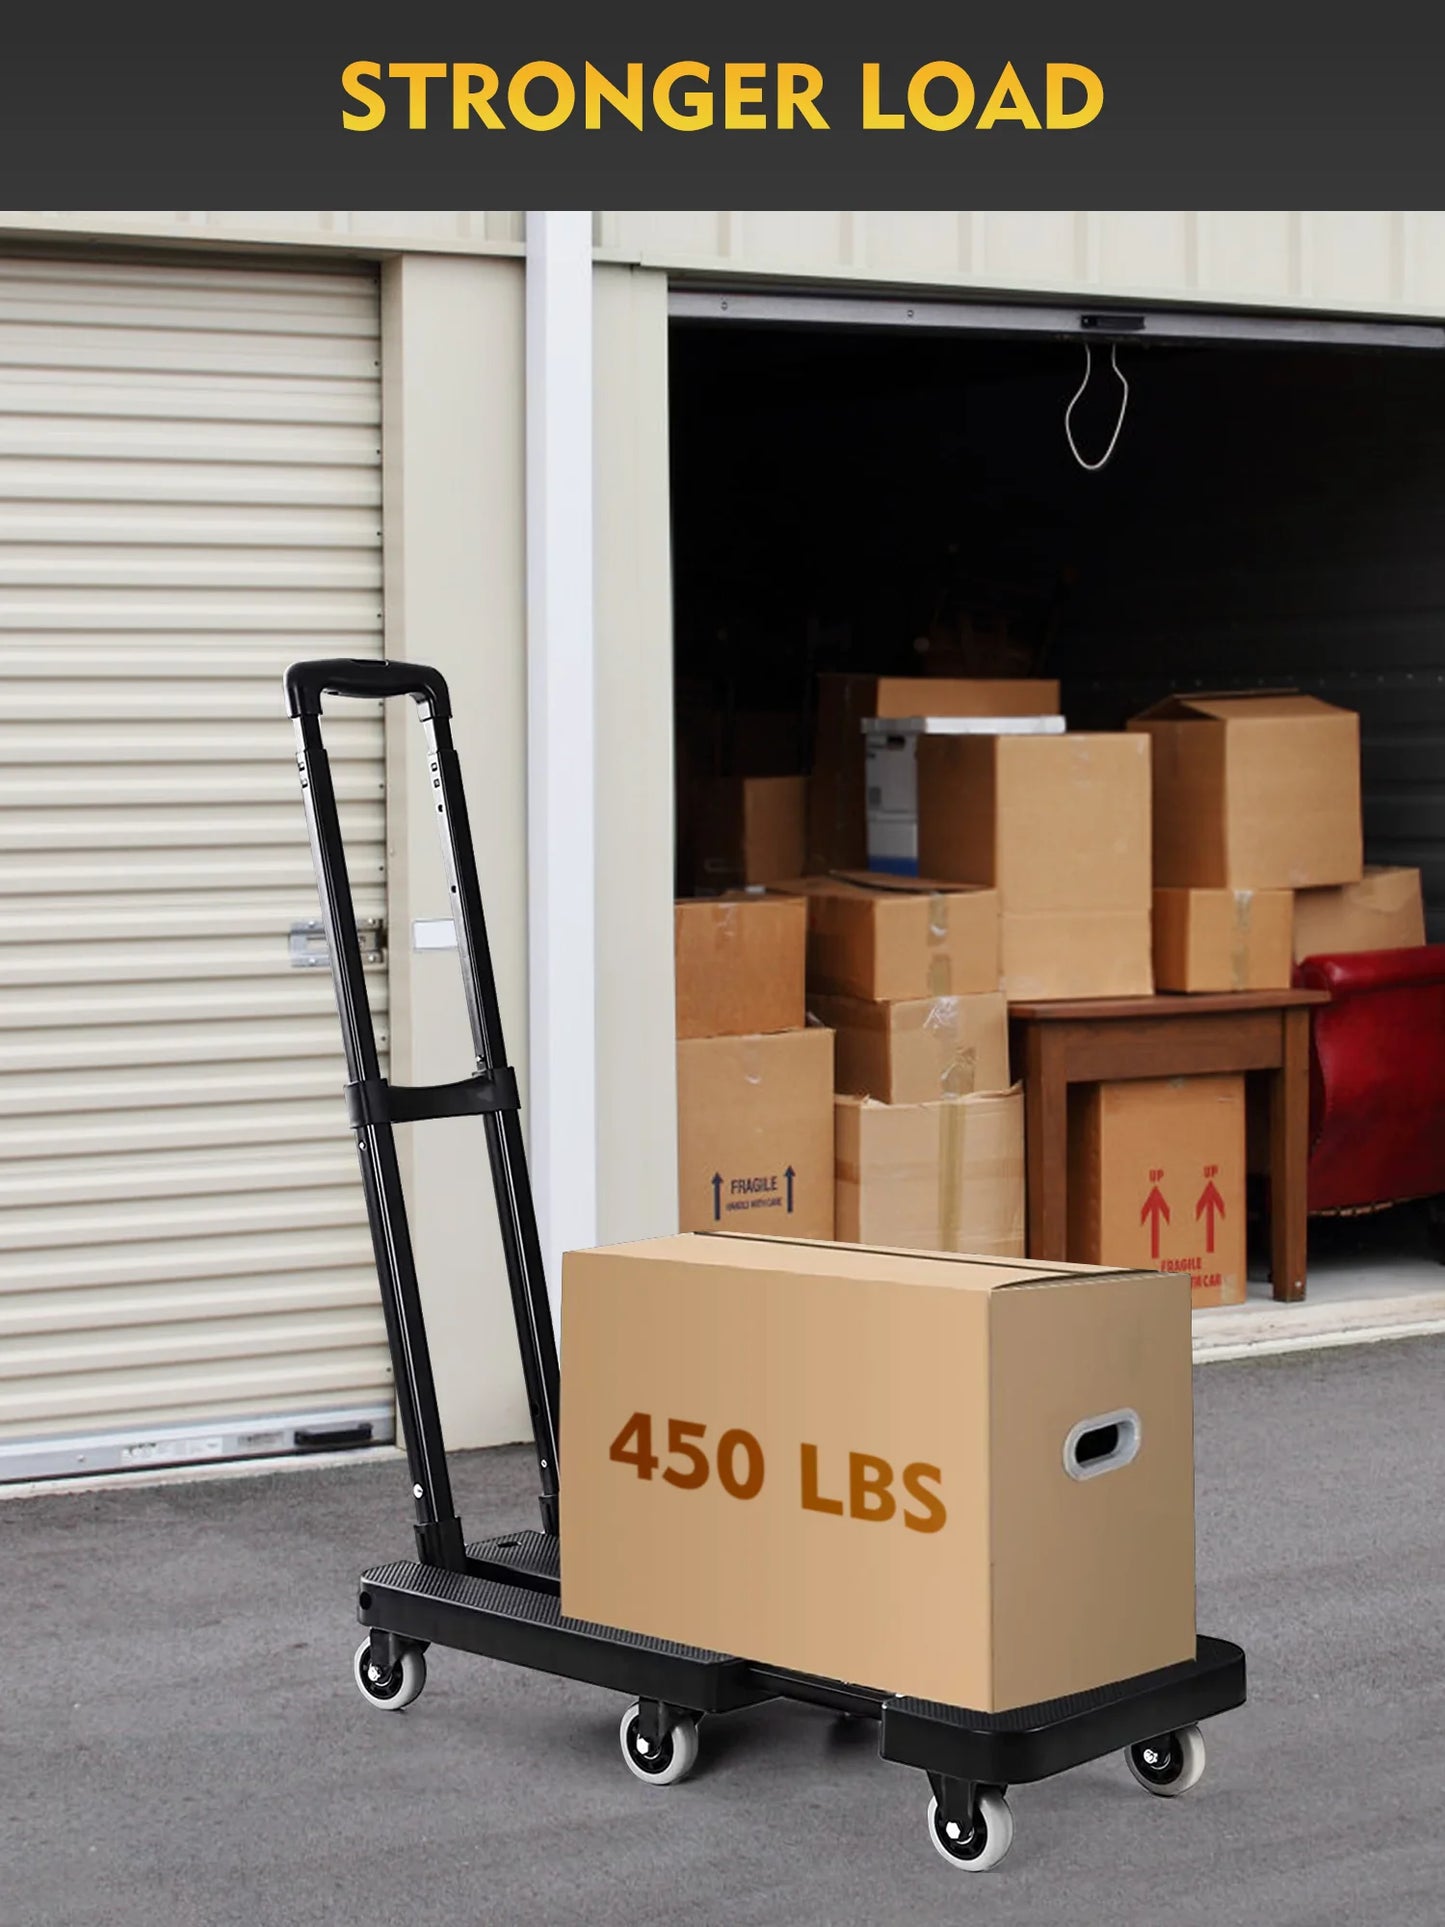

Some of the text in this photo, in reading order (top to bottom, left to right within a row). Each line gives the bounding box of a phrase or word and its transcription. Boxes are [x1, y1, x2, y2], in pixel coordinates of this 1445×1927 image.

[1149, 1169, 1164, 1182] UP
[1203, 1164, 1218, 1178] UP
[731, 1176, 778, 1194] FRAGILE
[1161, 1257, 1202, 1272] FRAGILE
[608, 1411, 947, 1534] 450 LBS
